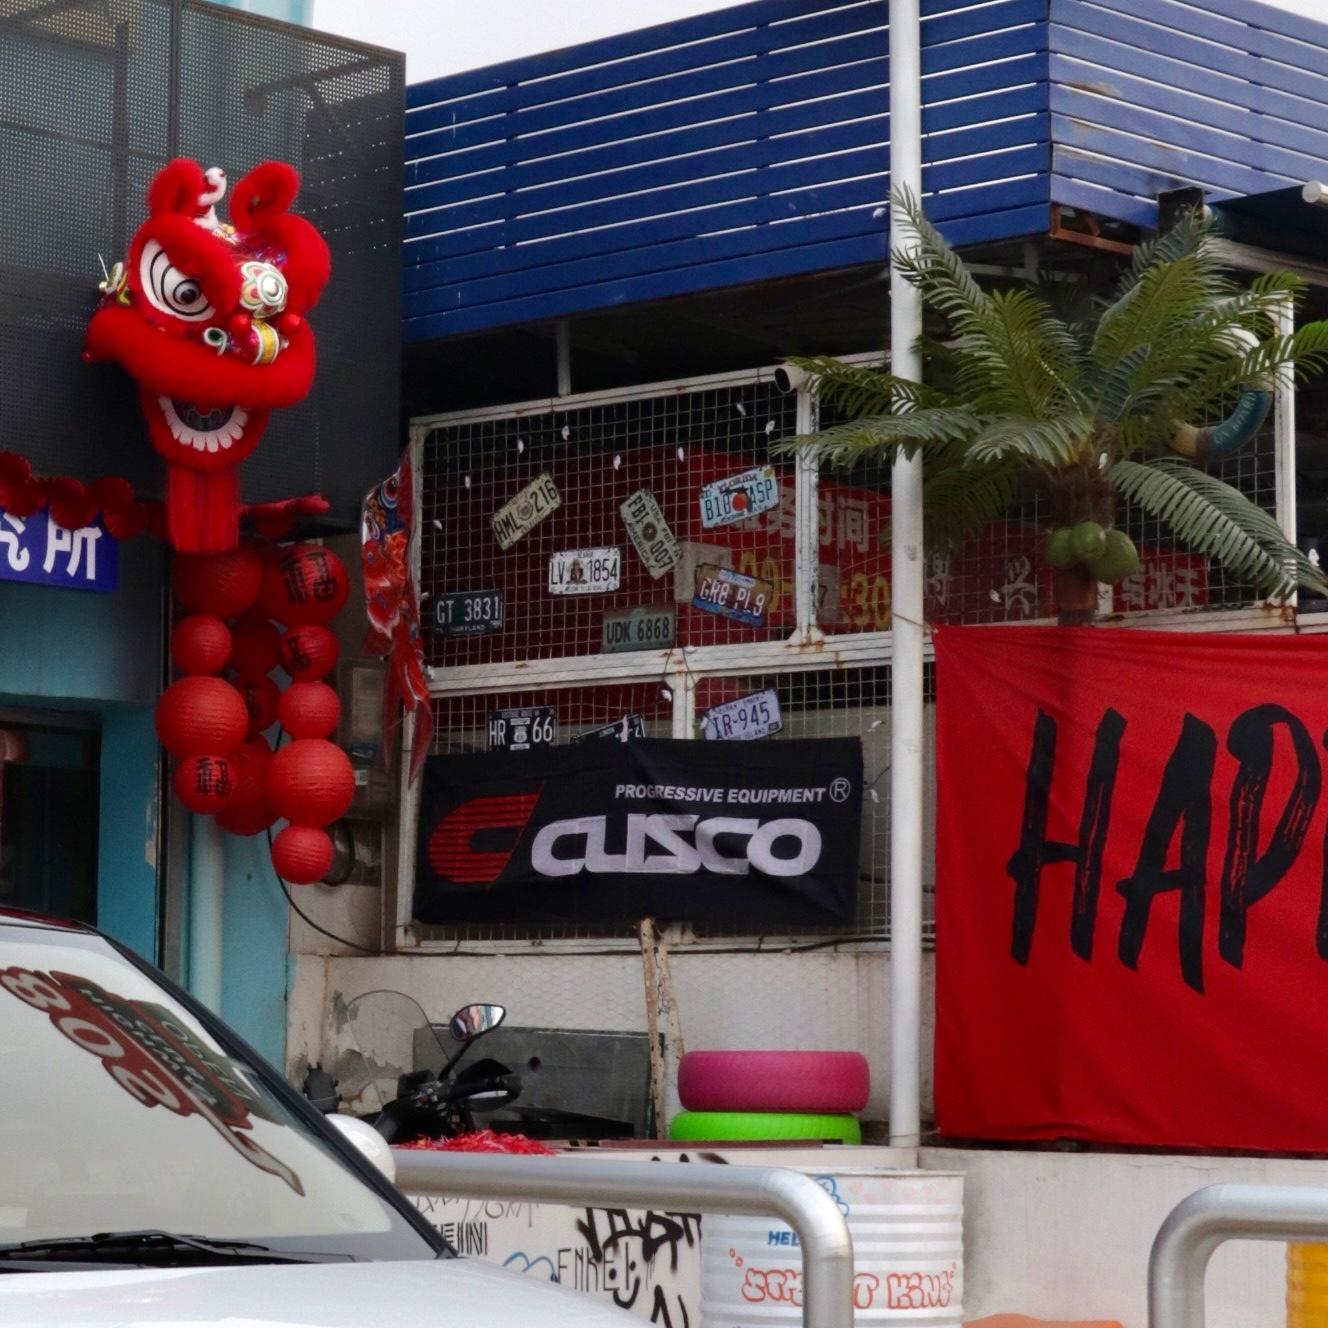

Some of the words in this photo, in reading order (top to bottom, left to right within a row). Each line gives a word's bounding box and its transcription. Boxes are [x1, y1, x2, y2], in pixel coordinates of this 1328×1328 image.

[587, 557, 618, 583] 1854
[436, 600, 455, 624] GT
[463, 596, 499, 622] 3831
[488, 718, 507, 747] HR
[532, 716, 553, 744] 66
[615, 784, 724, 803] PROGRESSIVE
[727, 787, 827, 804] EQUIPMENT
[531, 813, 822, 878] CUSCO
[1006, 703, 1328, 995] HAP
